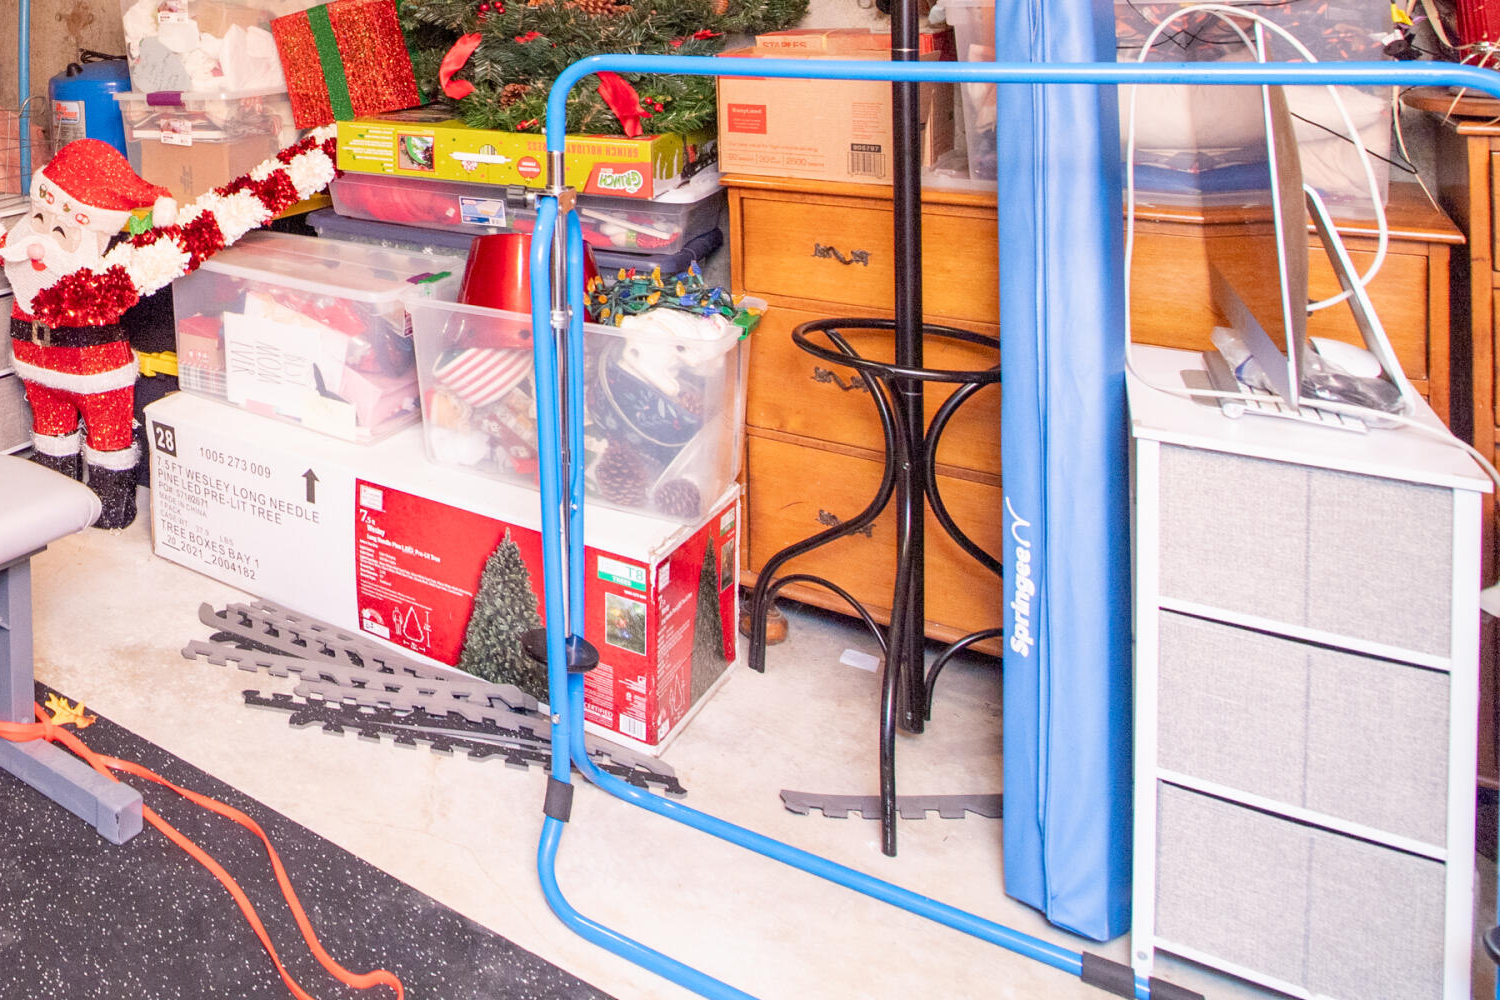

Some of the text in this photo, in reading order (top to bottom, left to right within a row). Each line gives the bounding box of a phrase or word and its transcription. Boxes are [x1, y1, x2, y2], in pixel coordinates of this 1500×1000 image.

[155, 426, 175, 452] 28
[200, 447, 271, 479] 1005 273 009
[157, 468, 283, 525] PINE LED PRE-LIT TREE
[186, 467, 231, 493] WESLEY
[233, 485, 266, 506] LONG
[269, 497, 320, 524] NEEDLE
[160, 518, 186, 539] TREE
[189, 531, 226, 556] BOXES
[228, 547, 251, 565] BAY
[625, 565, 644, 581] T8
